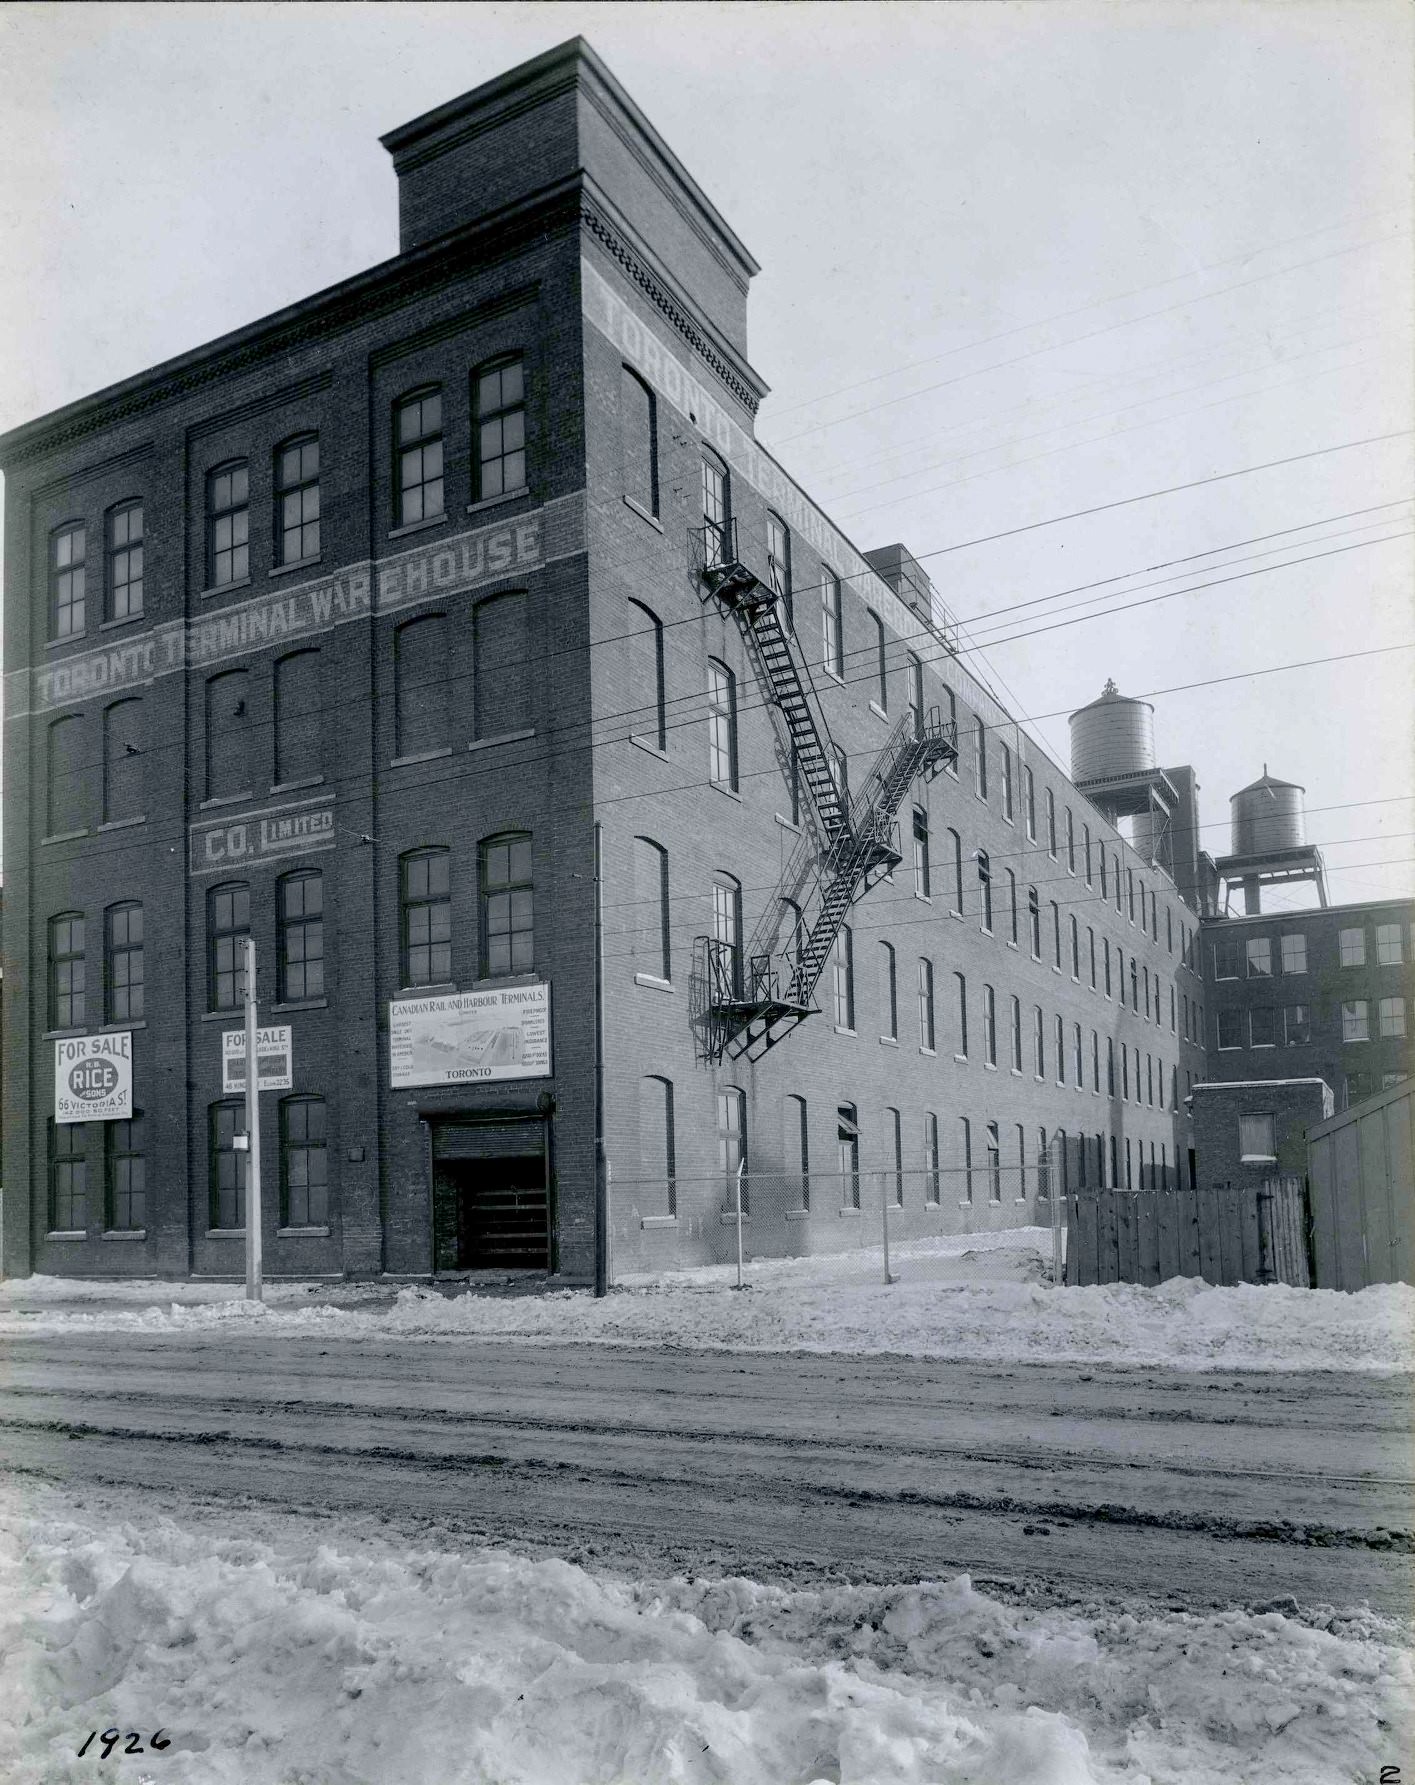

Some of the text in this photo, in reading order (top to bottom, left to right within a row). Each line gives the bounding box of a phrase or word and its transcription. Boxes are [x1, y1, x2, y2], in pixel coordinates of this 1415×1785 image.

[36, 523, 540, 701] TORONTO TERMINAL WAREHOUSE
[205, 824, 254, 860] CO.
[392, 1003, 428, 1016] CANADIAN
[429, 1001, 446, 1013] RAIL
[448, 999, 463, 1010] AND
[464, 996, 498, 1009] HARBOUR
[256, 1029, 286, 1044] SALE
[58, 1036, 130, 1066] FOR SALE
[73, 1067, 113, 1089] RICE
[445, 1067, 492, 1079] TORONTO
[85, 1088, 107, 1098] SONS
[59, 1097, 69, 1110] 66
[70, 1097, 117, 1110] VICTORIA
